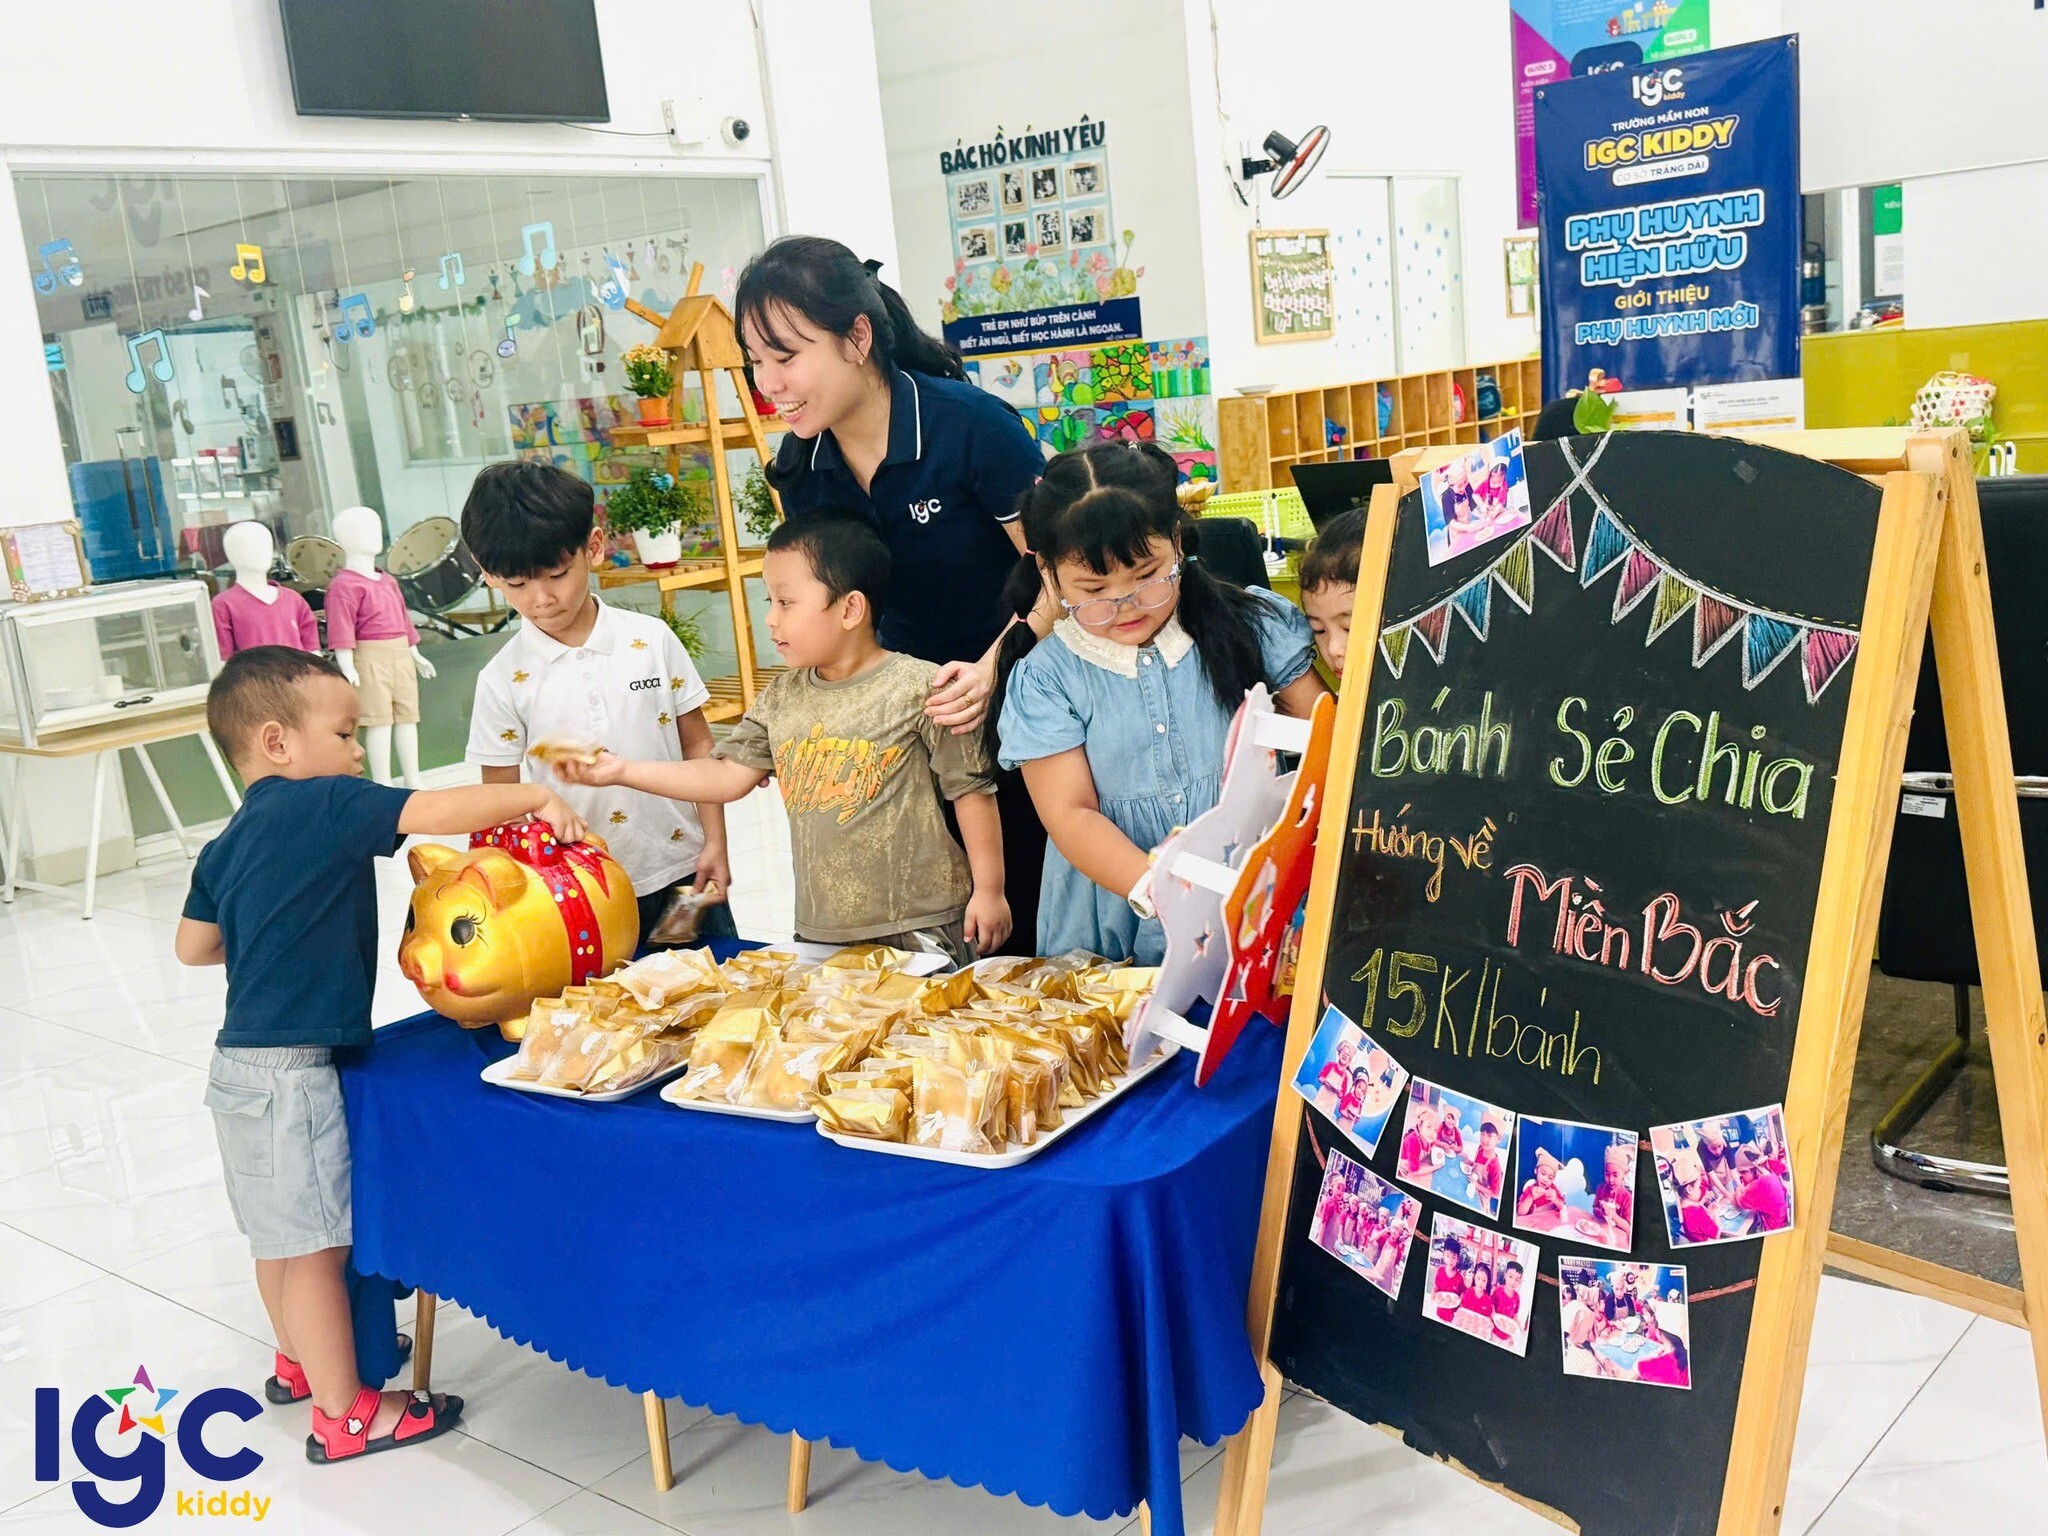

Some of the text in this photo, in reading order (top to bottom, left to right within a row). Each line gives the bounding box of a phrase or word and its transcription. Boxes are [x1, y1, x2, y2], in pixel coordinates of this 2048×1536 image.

[940, 113, 1106, 174] BÁC HỒ KÍNH YÊU
[1586, 118, 1737, 168] IGC KIDDY
[1611, 116, 1656, 132] TRƯỜNG
[1684, 106, 1709, 119] NON
[1568, 192, 1761, 247] PHỤ HUYNH
[1584, 233, 1744, 283] HIỆN HỮU
[997, 318, 1010, 331] EM
[1010, 316, 1030, 330] NHƯ
[1048, 311, 1071, 325] TRÊN
[1614, 283, 1711, 311] GIỚI THIỆU
[1011, 330, 1030, 345] BIẾT
[1031, 329, 1050, 344] HỌC
[1076, 325, 1089, 337] LÀ
[1577, 302, 1757, 343] PHỤ HUYNH MỚI
[629, 677, 662, 691] GUCCI
[1371, 686, 1816, 819] Bánh Sẻ Chia
[1351, 803, 1498, 903] Hướng về
[1503, 863, 1783, 1018] Miền Bắc
[1350, 947, 1602, 1086] 15K/bánh
